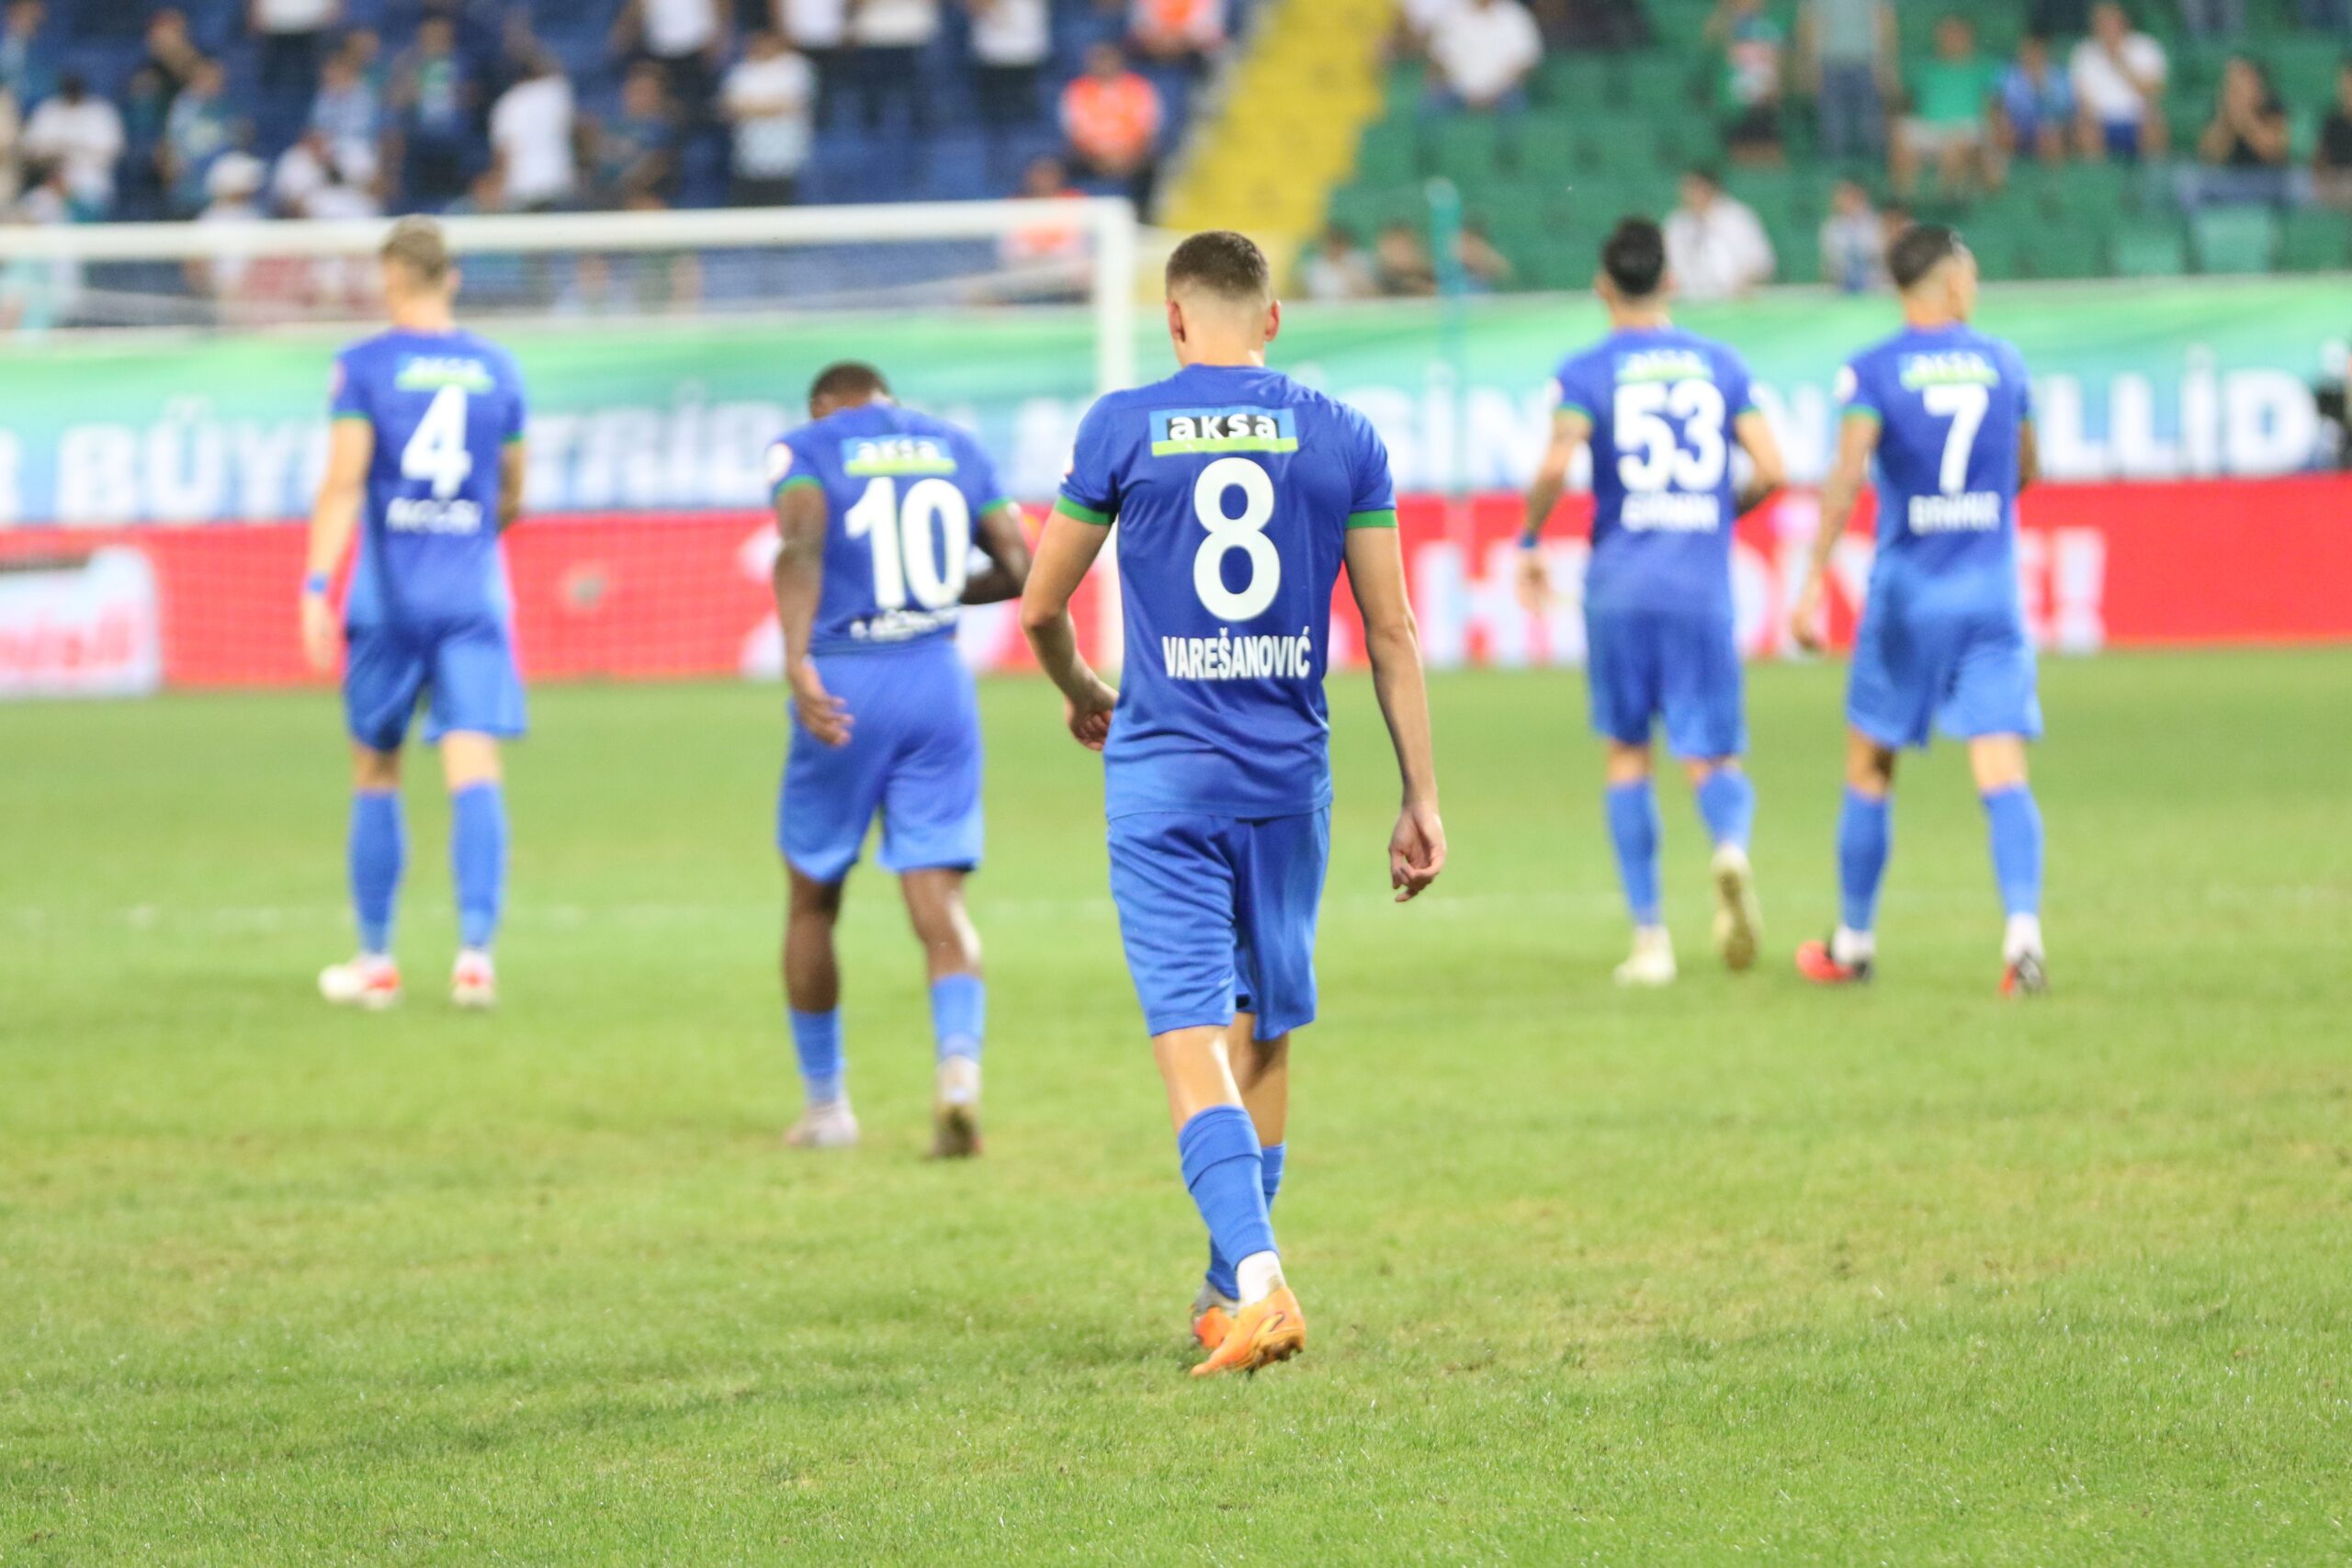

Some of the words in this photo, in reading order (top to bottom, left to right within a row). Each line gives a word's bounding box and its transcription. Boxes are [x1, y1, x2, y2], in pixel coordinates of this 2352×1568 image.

[401, 384, 472, 499] 4
[1170, 412, 1278, 441] aksa
[1614, 379, 1727, 492] 53
[1923, 384, 1989, 493] 7
[844, 476, 970, 610] 10
[1194, 457, 1281, 621] 8
[1162, 626, 1311, 680] VAREŠANOVIĆ
